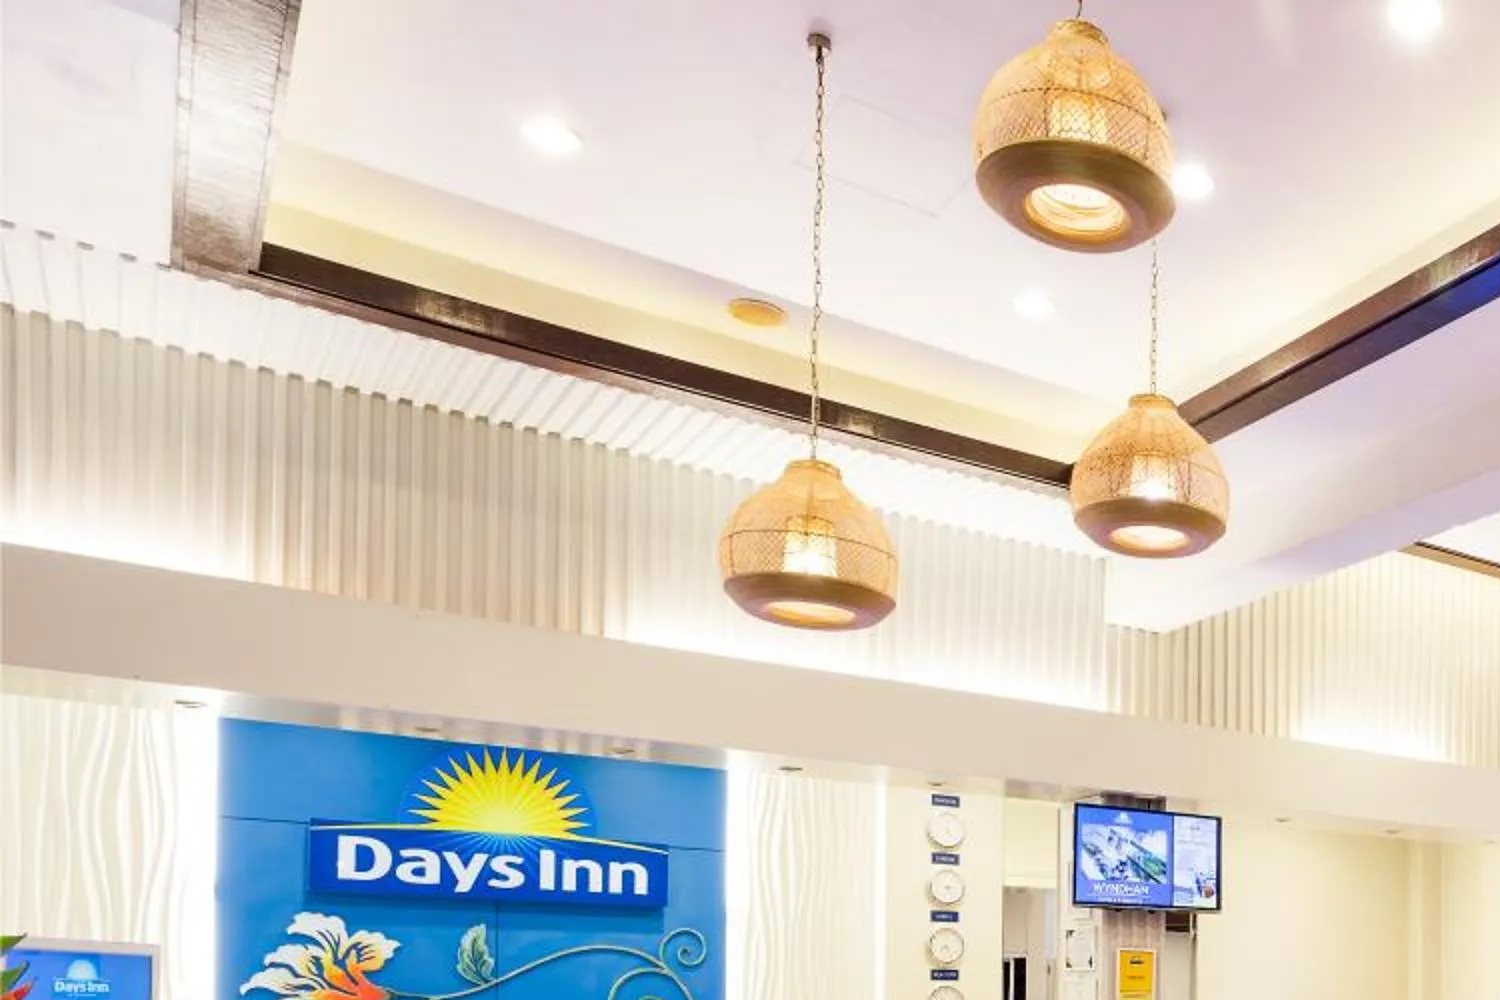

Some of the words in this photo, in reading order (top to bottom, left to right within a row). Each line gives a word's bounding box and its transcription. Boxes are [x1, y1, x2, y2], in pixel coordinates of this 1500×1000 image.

[336, 834, 526, 893] Days
[538, 849, 650, 895] Inn
[54, 981, 87, 993] Days
[87, 981, 110, 993] Inn
